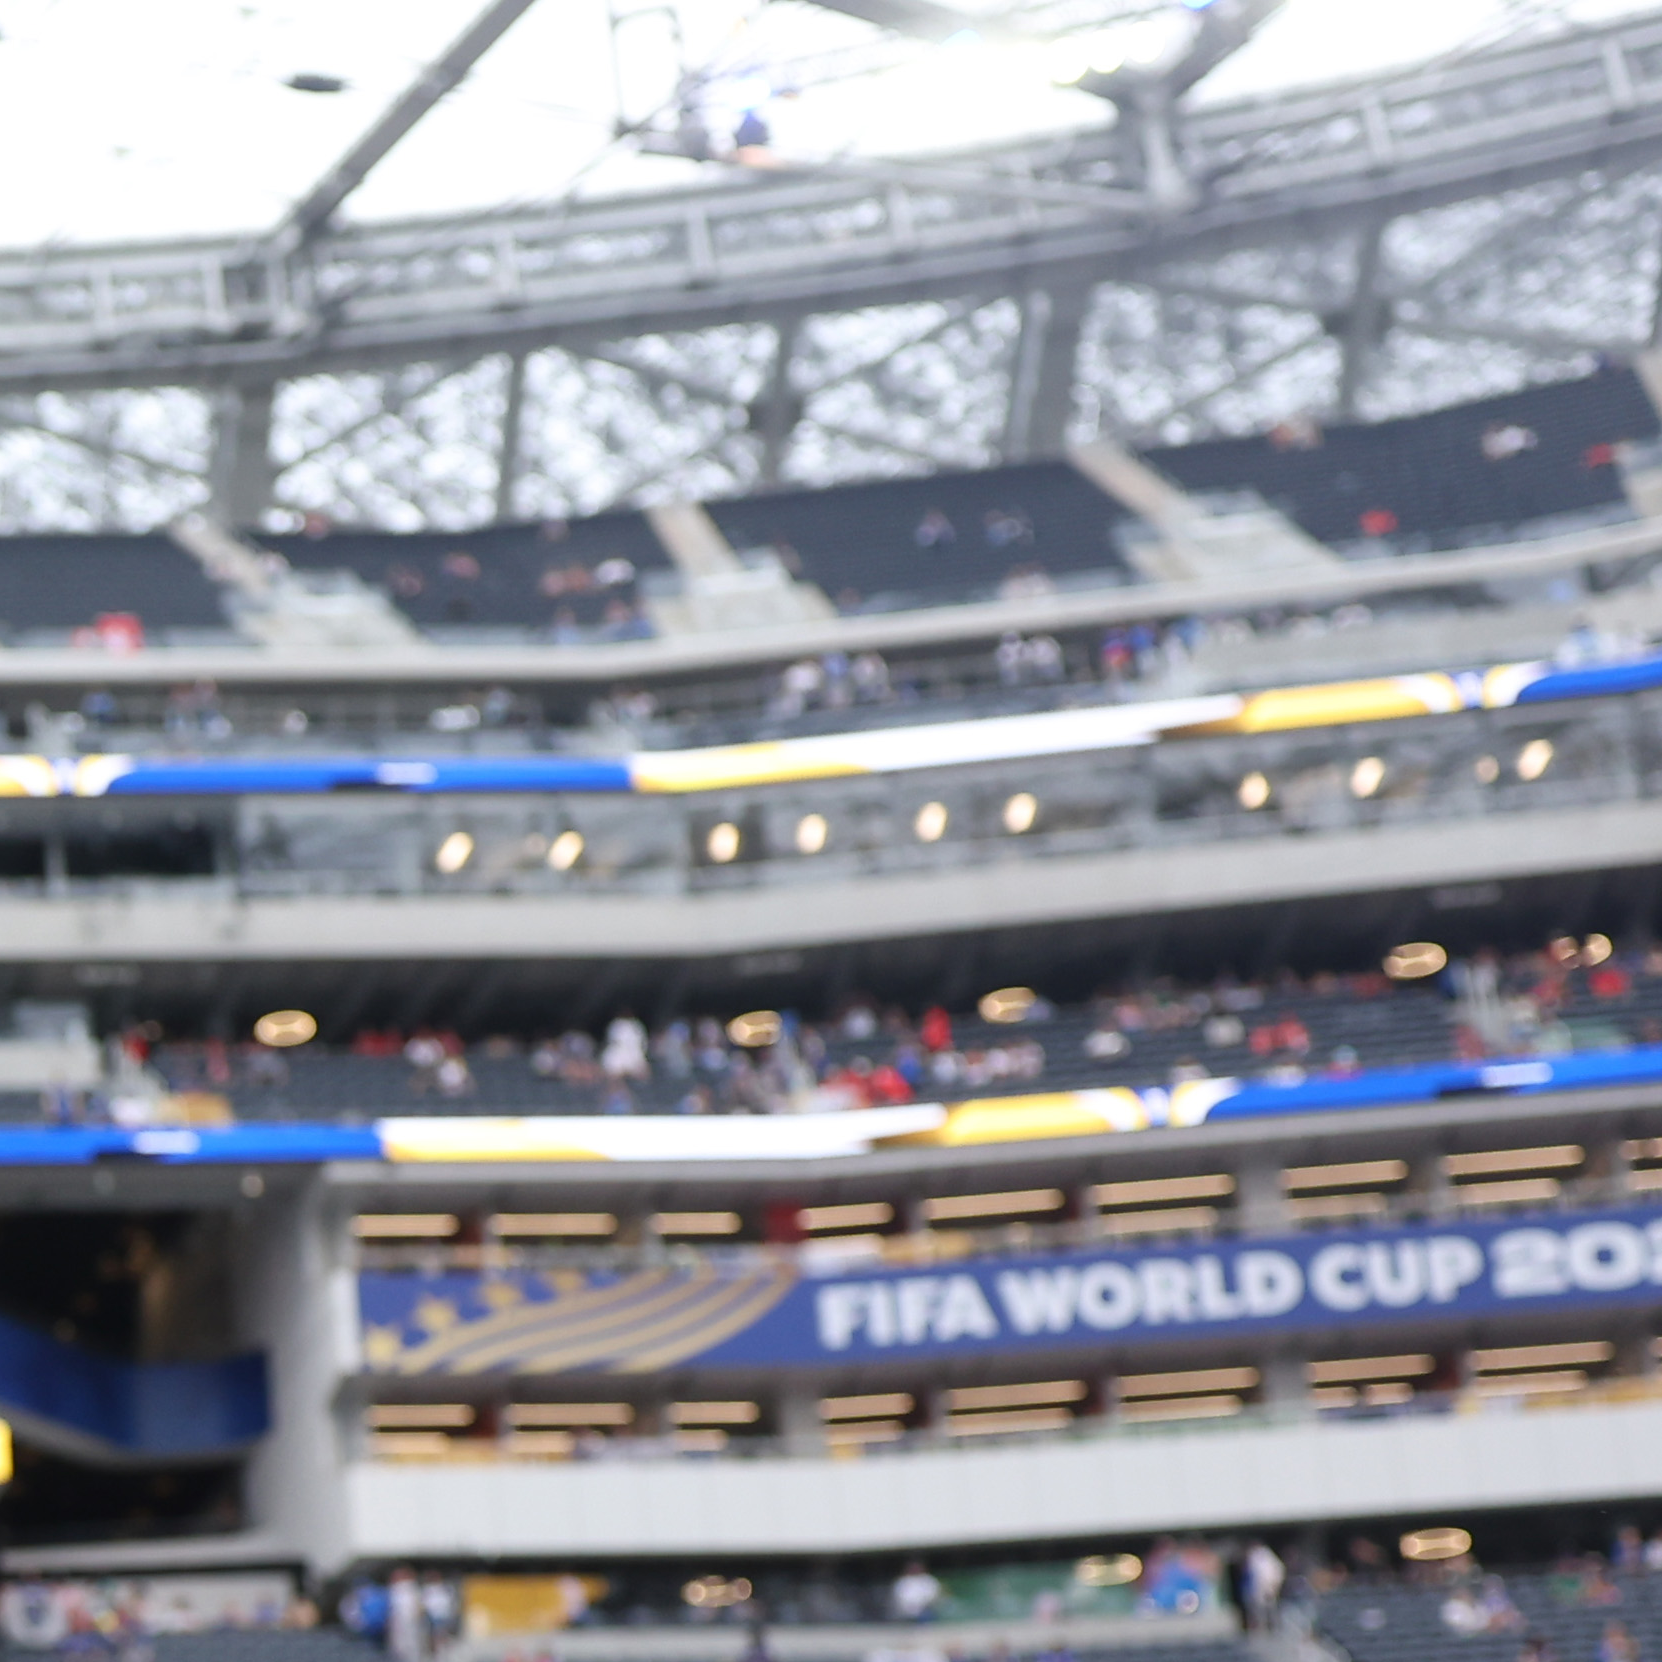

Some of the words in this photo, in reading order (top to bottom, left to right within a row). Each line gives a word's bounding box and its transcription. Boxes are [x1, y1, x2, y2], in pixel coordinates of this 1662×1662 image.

[817, 1272, 999, 1353] FIFA
[995, 1247, 1306, 1335] WORLD
[1308, 1232, 1485, 1312] CUP
[1489, 1218, 1662, 1299] 20
